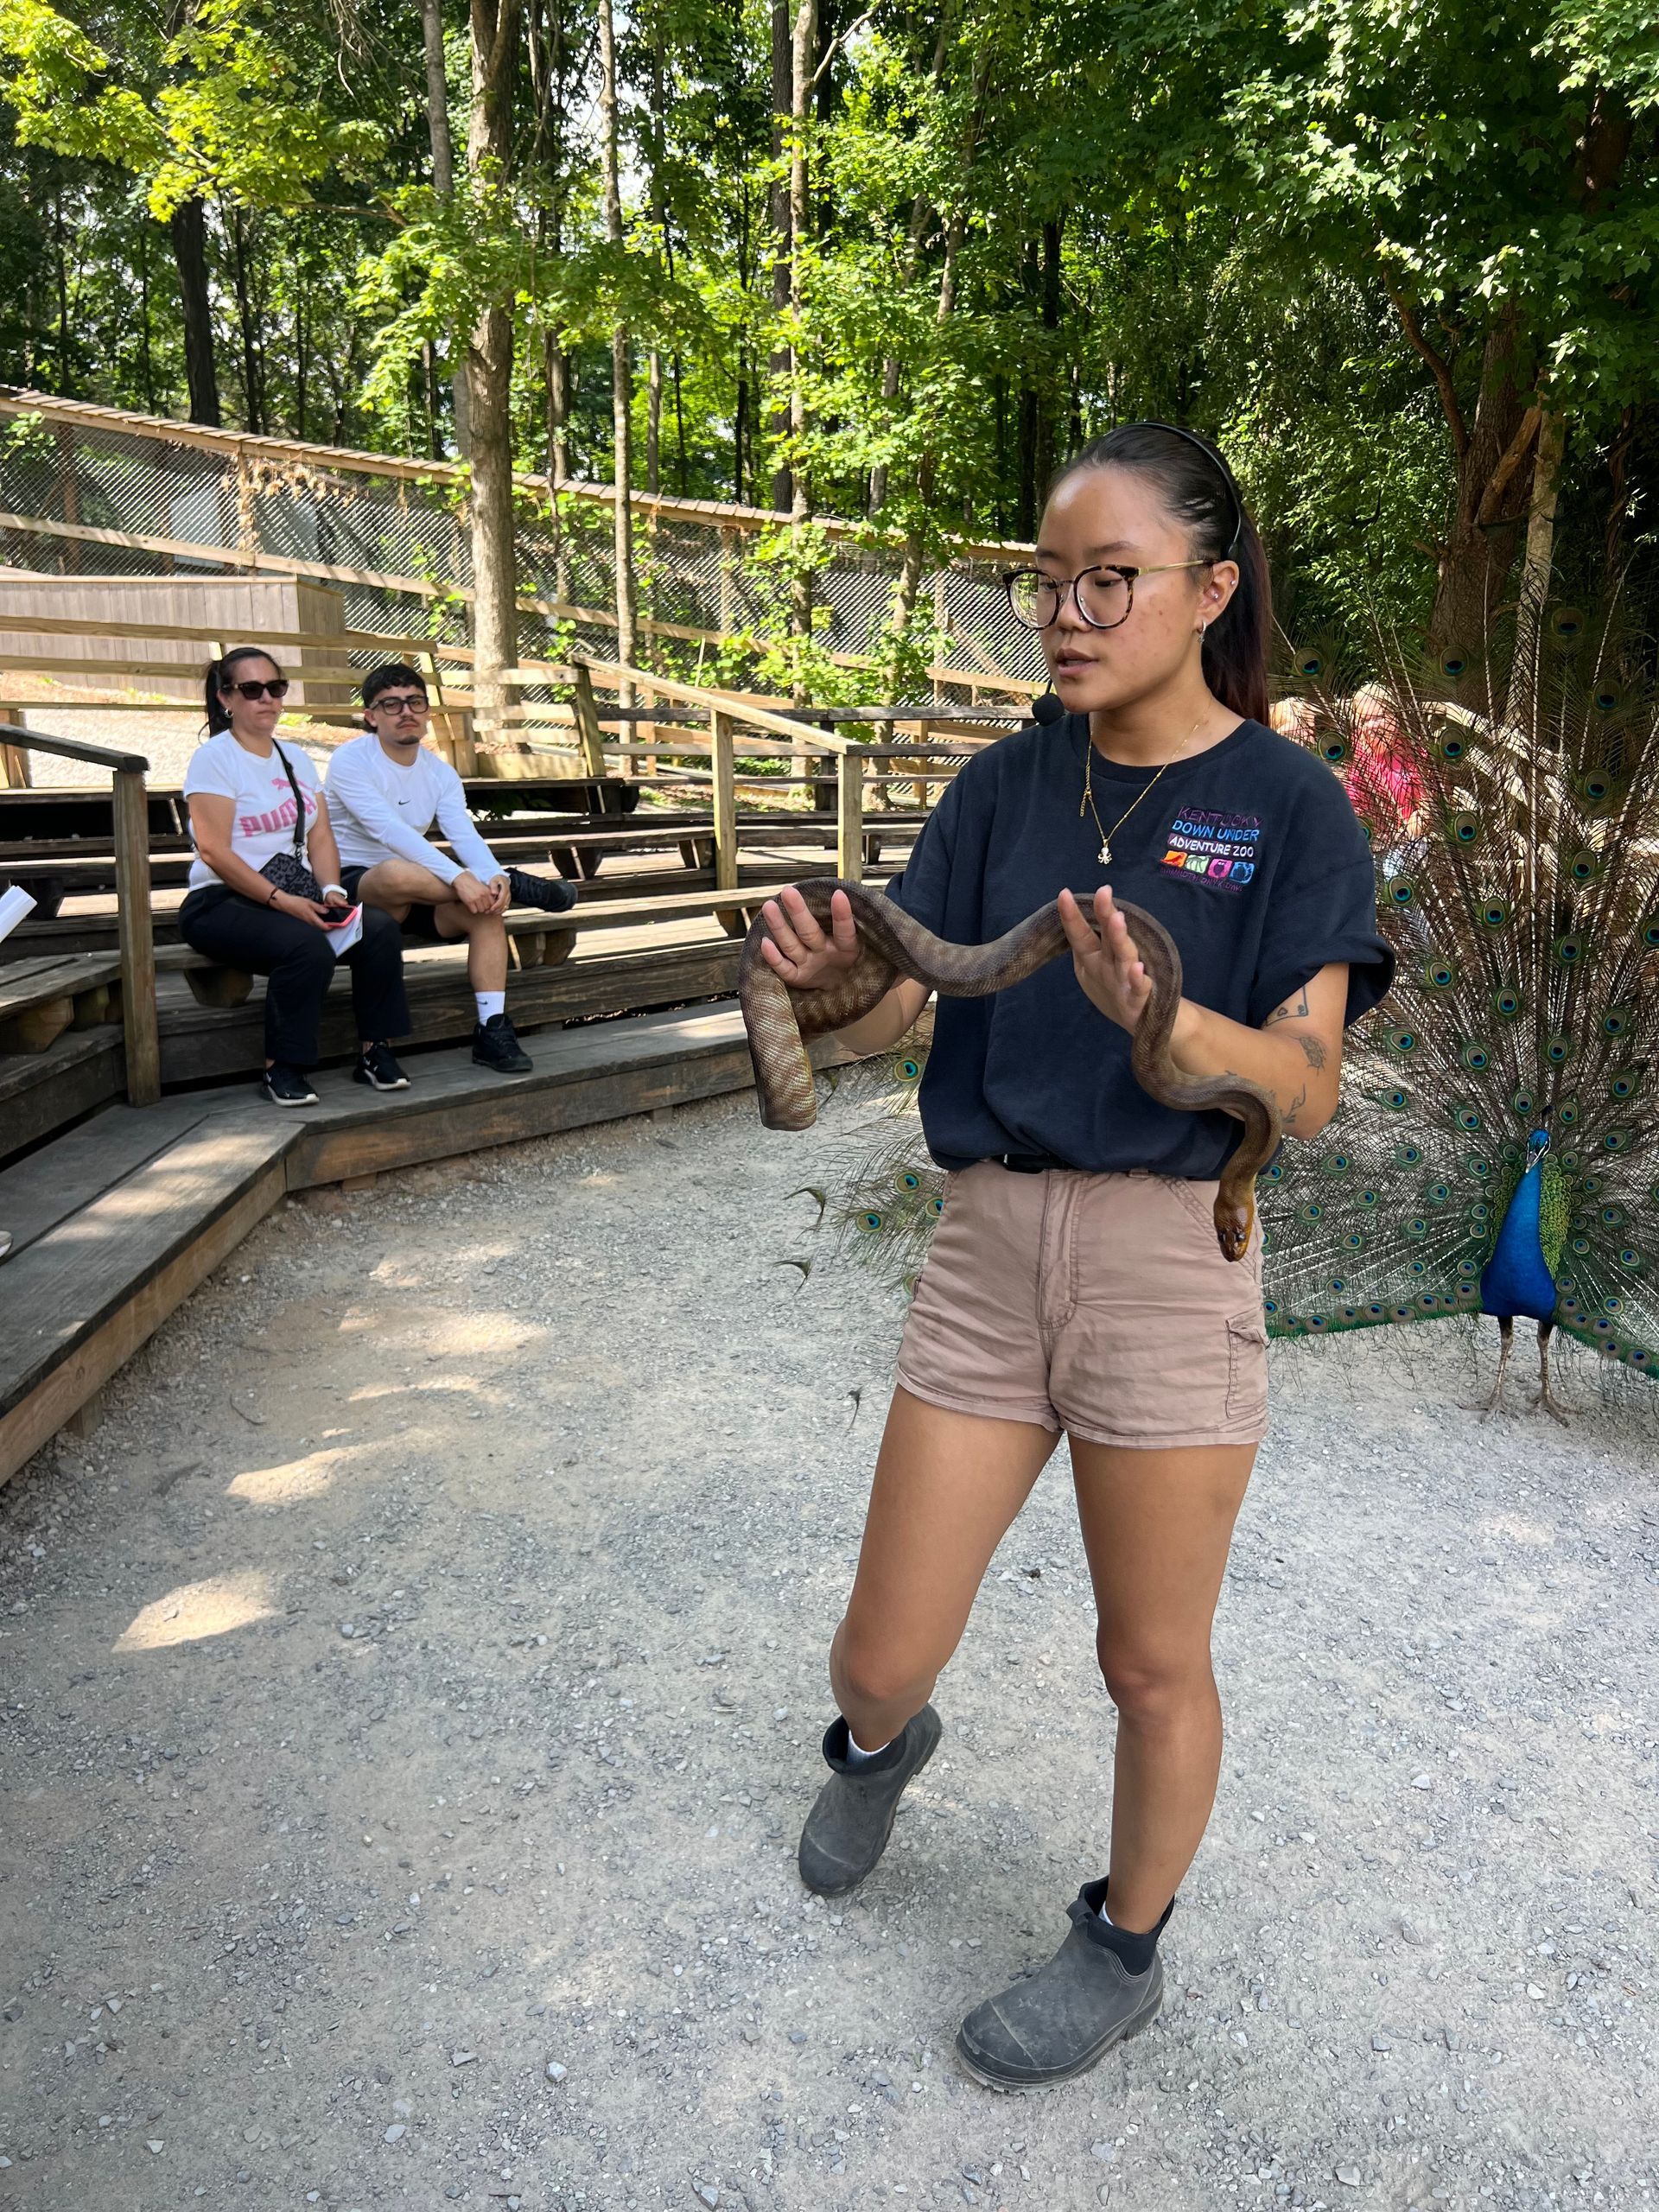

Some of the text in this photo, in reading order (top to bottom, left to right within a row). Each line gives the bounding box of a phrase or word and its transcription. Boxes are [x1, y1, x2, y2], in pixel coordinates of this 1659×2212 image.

[1178, 806, 1264, 827] KENTUCKY
[1172, 819, 1260, 842] DOWN UNDER
[1169, 836, 1255, 858] ADVENTURE ZOO
